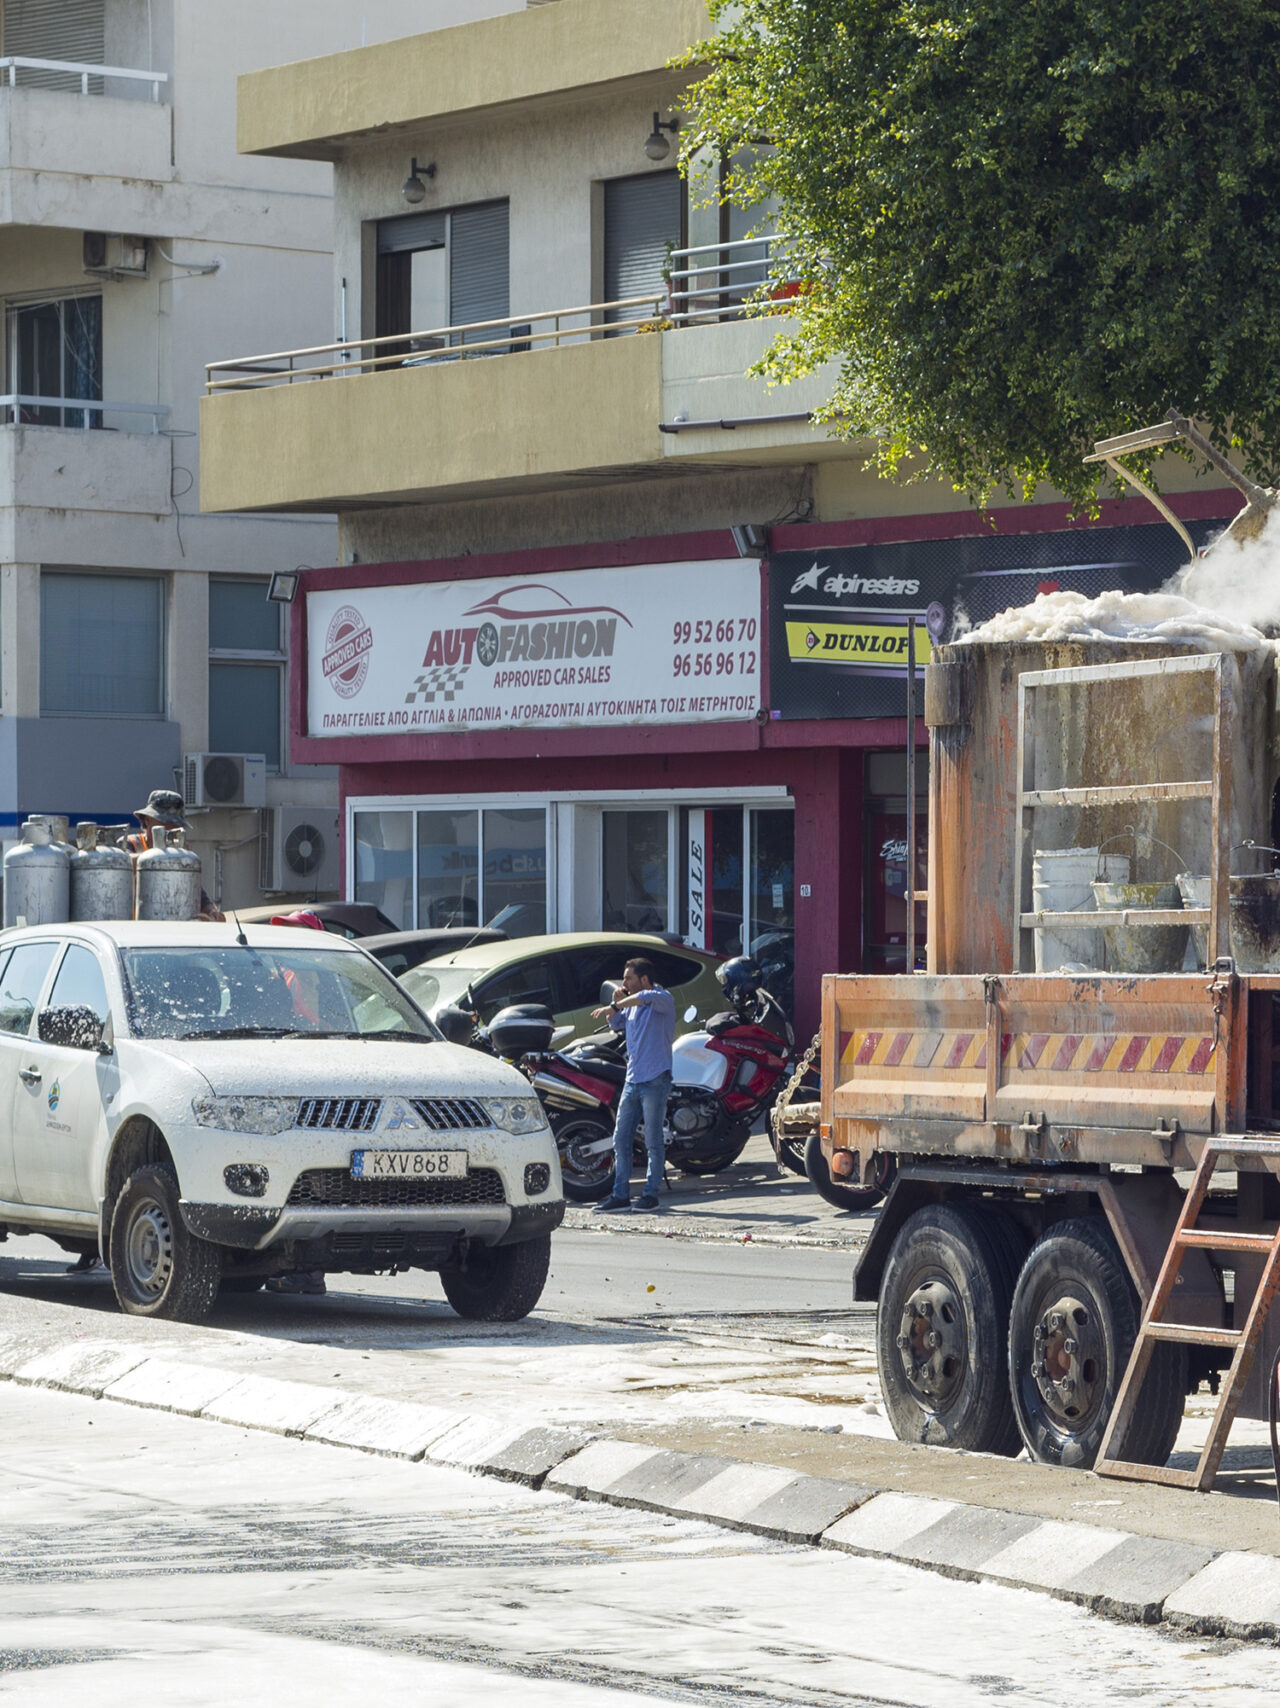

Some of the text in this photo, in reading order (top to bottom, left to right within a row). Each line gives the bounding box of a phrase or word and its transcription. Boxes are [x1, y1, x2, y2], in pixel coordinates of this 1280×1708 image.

[823, 573, 920, 598] alpinestars
[673, 617, 756, 645] 99 52 66 70
[822, 633, 909, 653] DUNLOP
[324, 630, 372, 675] APPROVED CARS
[673, 651, 756, 677] 96 56 96 12
[493, 665, 611, 689] APPROVED CAR SALES
[322, 695, 756, 728] ΠΑΡΑΓΓΕΛΙΕΣ ΑΠΟ ΑΓΓΛΙΑ & ΙΑΠΩΝΙΑ ΑΓΟΡΑΖΟΝΤΑΙ ΑΥΤΟΚΙΝΗΤΑ ΤΟΙΣ ΜΕΤΡΗΤΟΙΣ
[691, 839, 703, 932] SALE
[801, 886, 809, 896] 10
